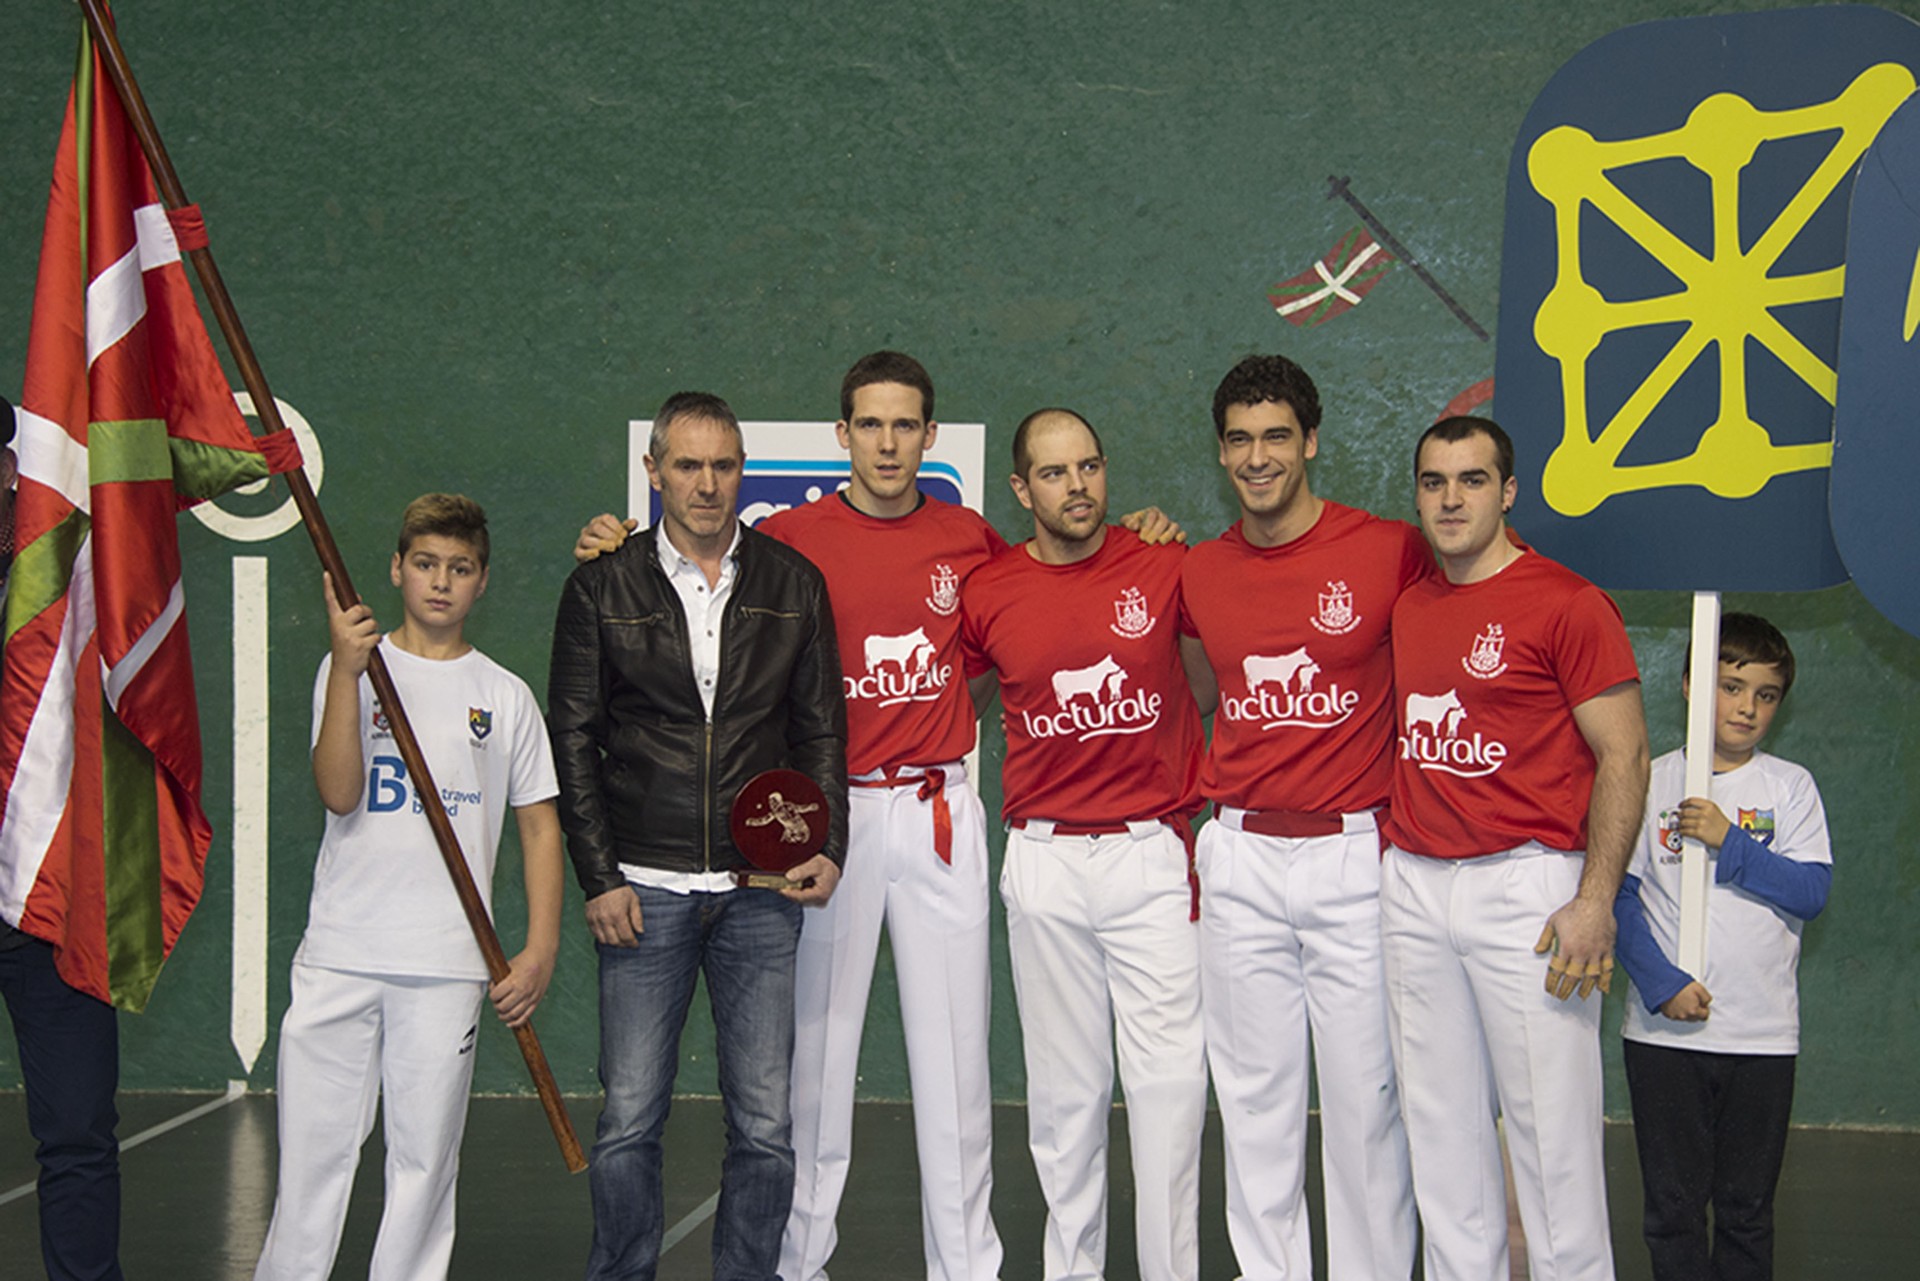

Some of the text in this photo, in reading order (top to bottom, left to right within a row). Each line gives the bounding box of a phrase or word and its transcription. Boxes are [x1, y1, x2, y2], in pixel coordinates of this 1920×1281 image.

[843, 661, 953, 699] acturale
[1022, 687, 1162, 739] lacturale
[442, 788, 482, 804] travel
